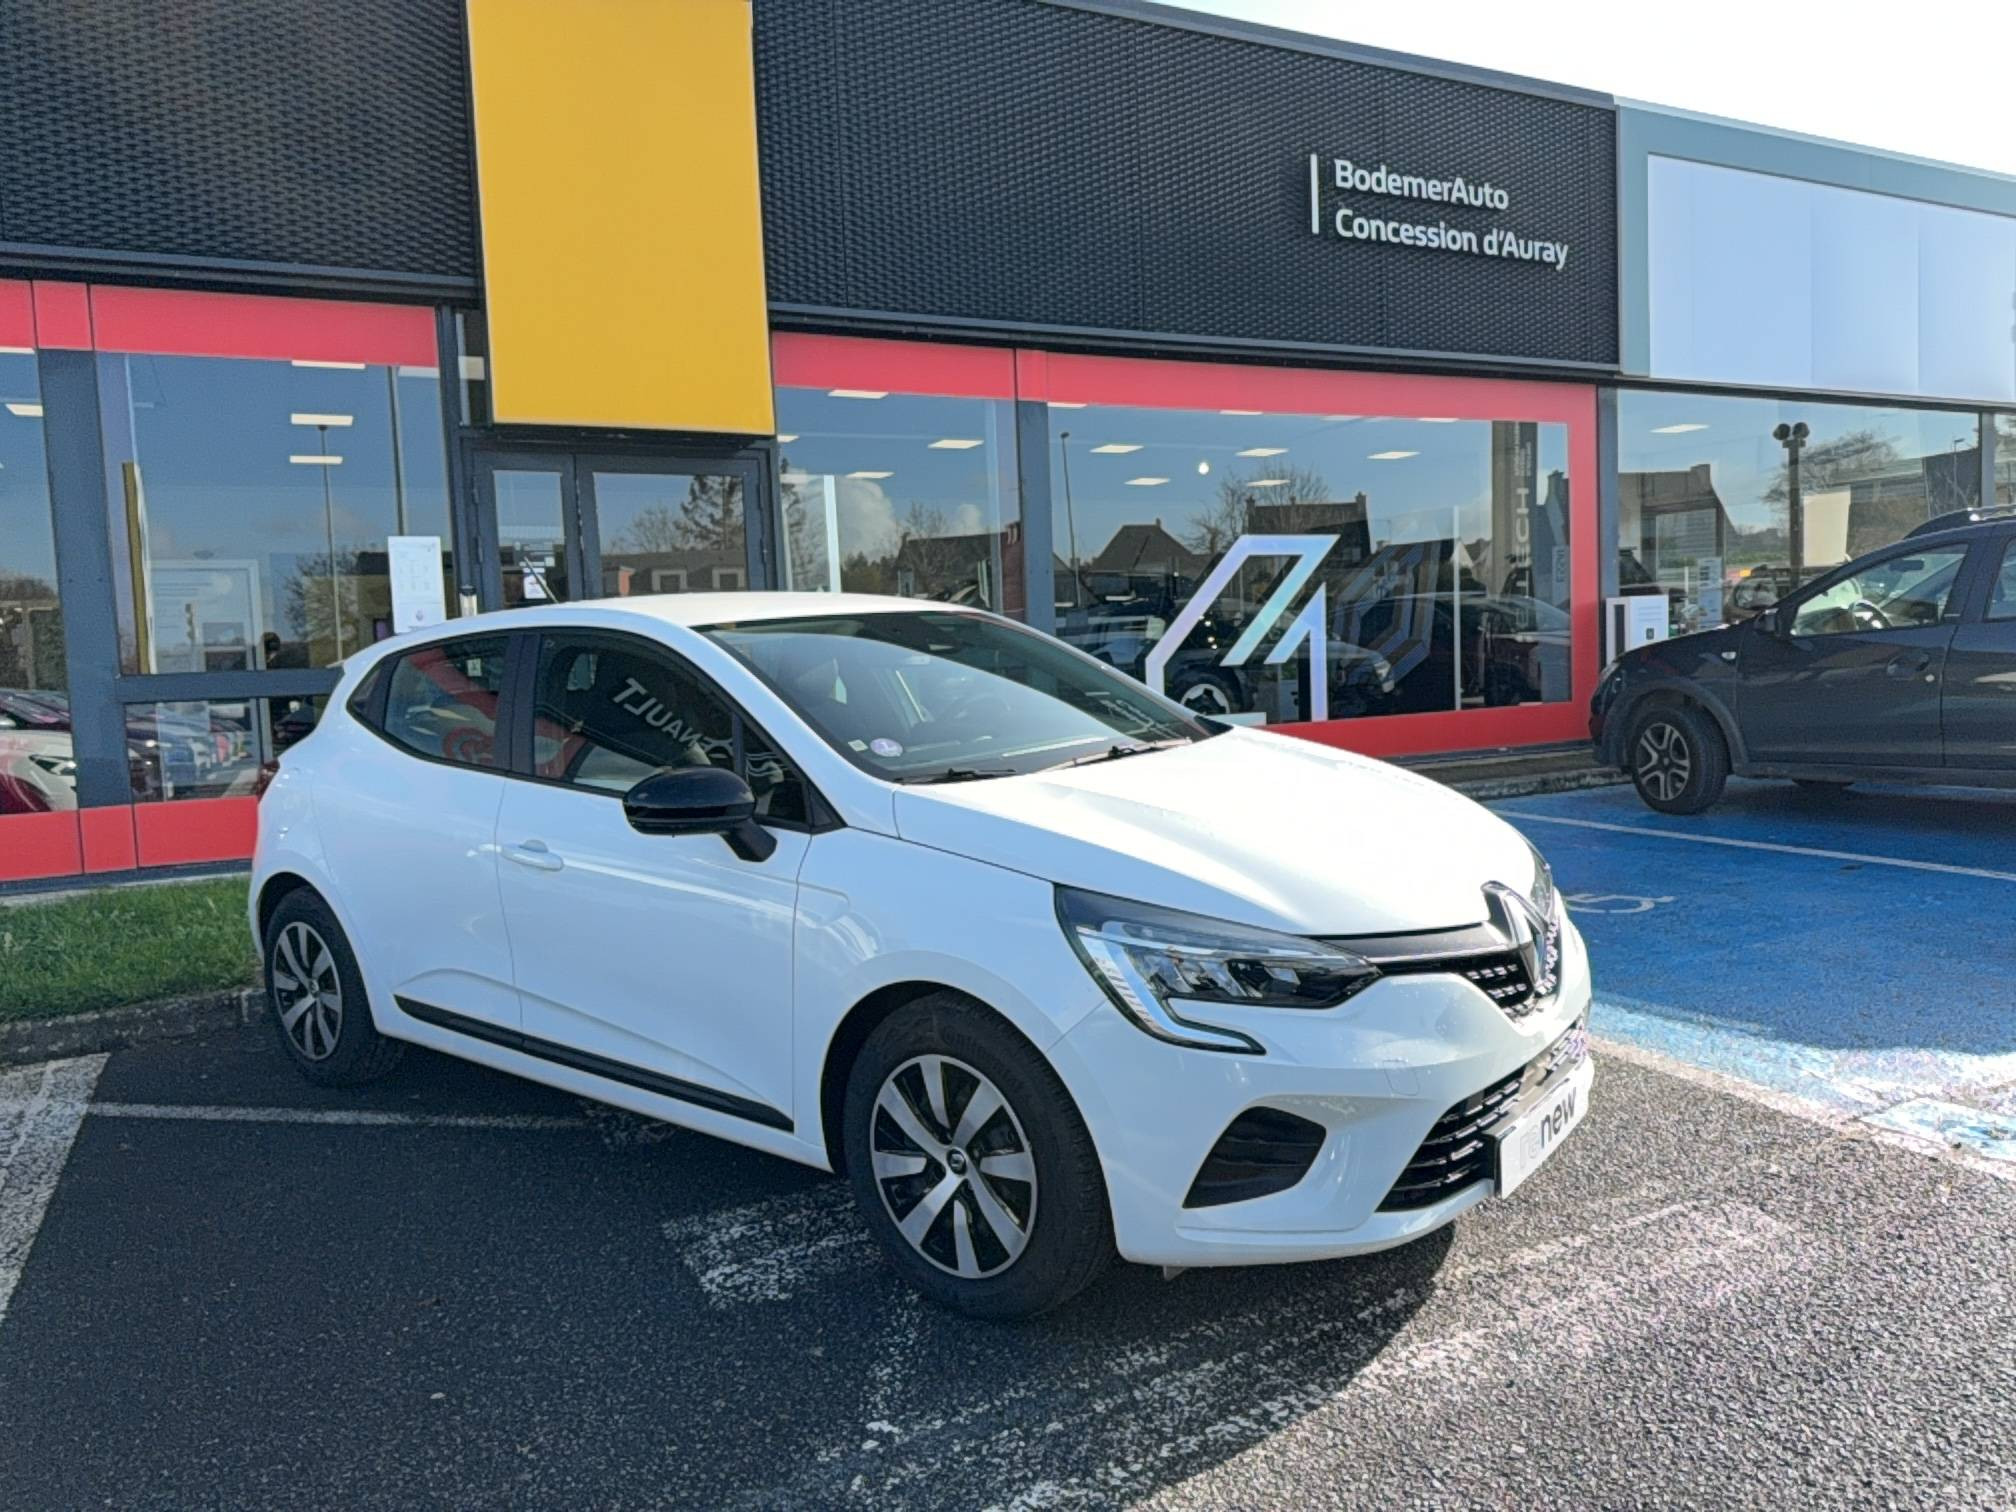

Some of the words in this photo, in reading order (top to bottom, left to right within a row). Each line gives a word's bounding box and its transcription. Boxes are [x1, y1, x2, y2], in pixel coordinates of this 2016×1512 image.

[1334, 158, 1509, 210] BodemerAuto
[1335, 208, 1479, 254] Concession
[1483, 226, 1569, 271] d'Auray
